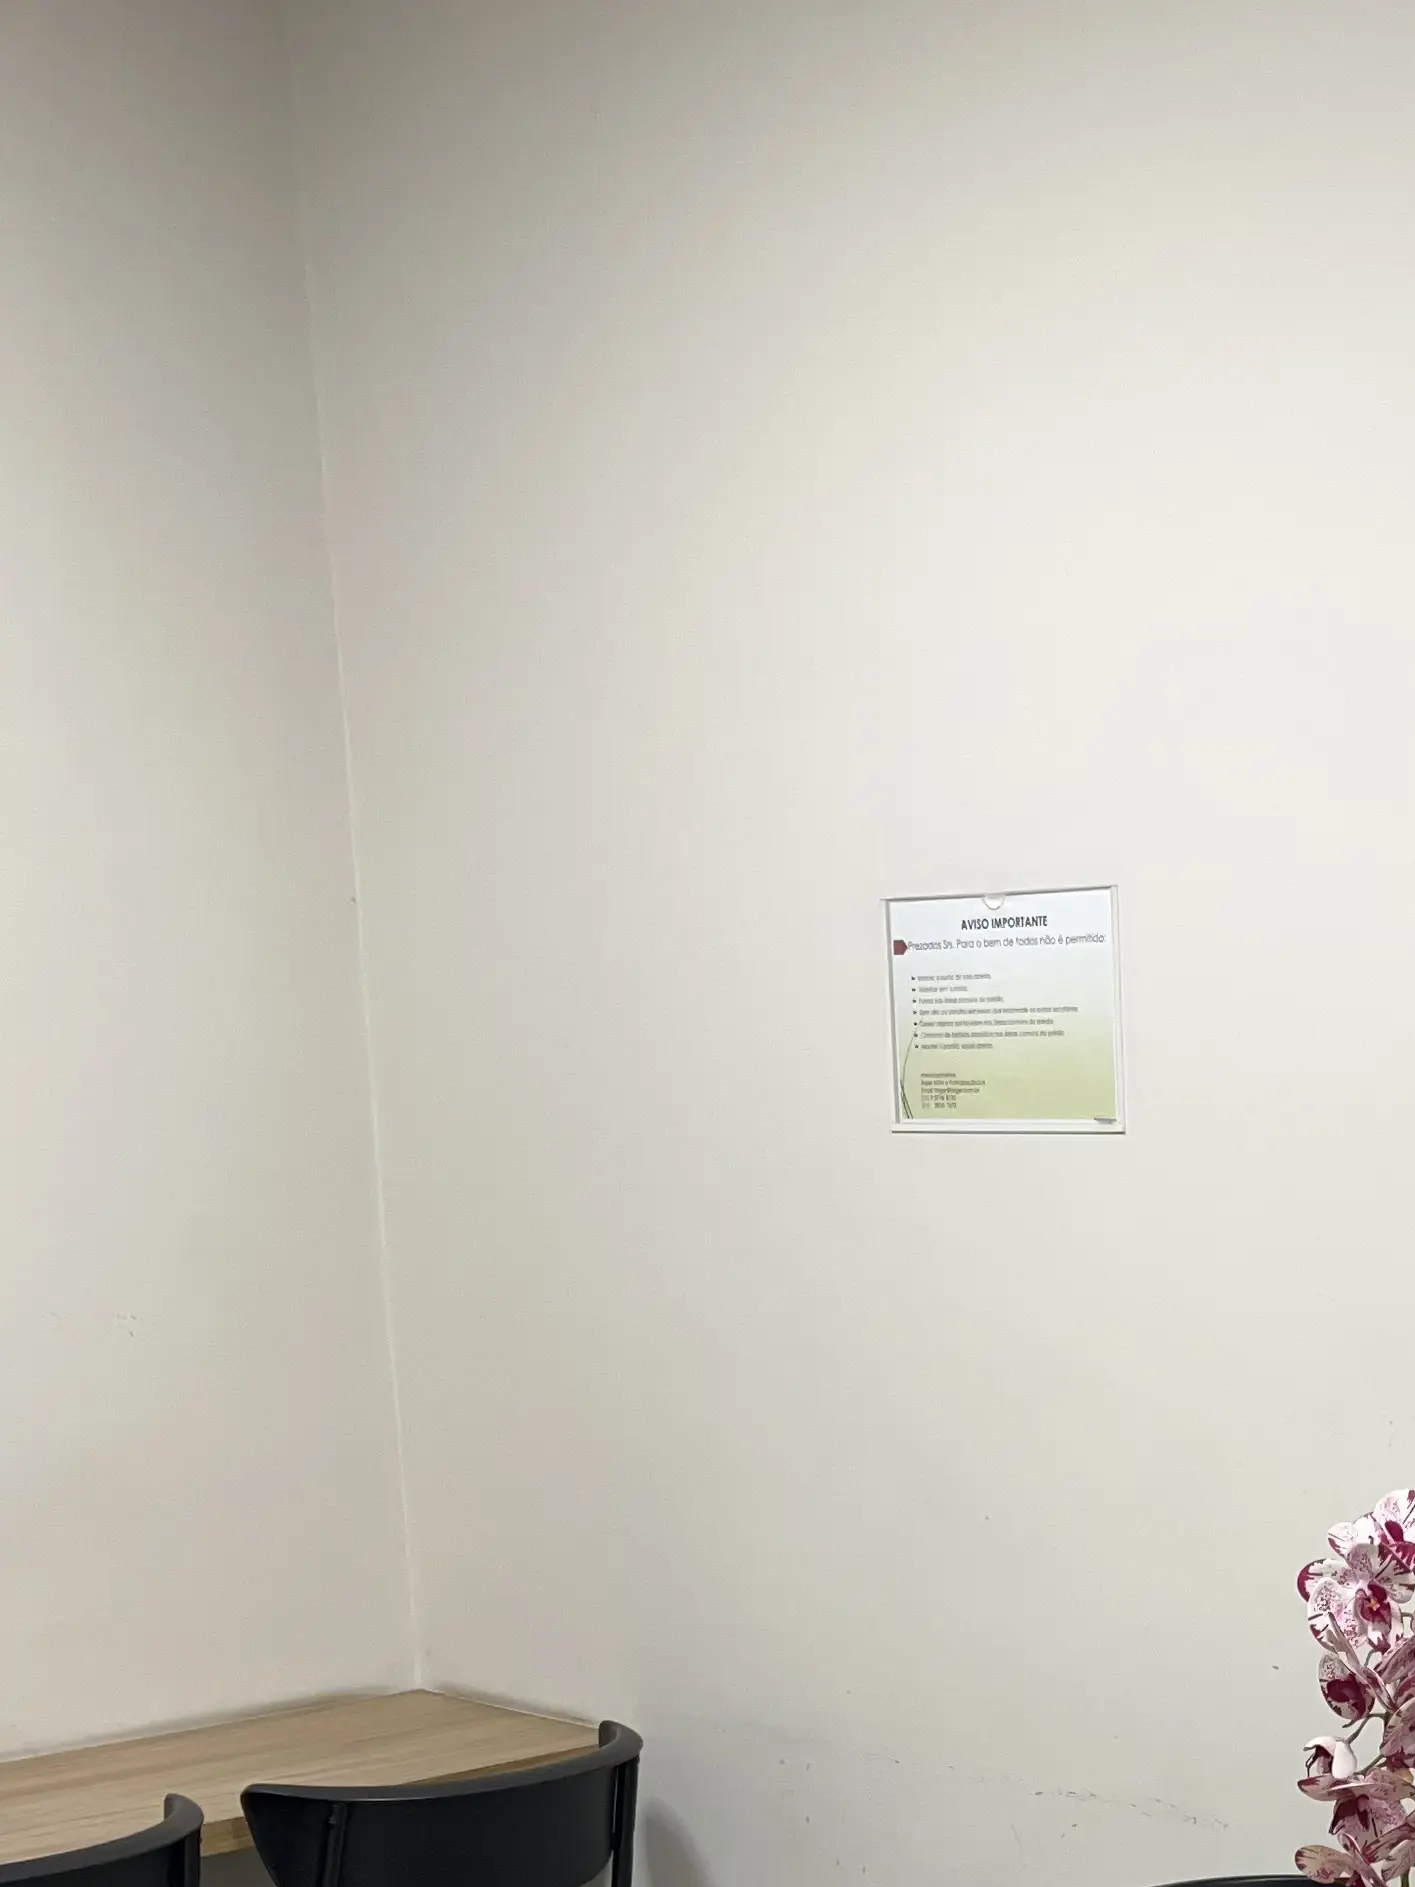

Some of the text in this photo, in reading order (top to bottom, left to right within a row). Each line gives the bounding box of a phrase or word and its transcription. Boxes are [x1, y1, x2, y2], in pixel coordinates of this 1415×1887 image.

[961, 915, 1048, 931] AVISO IMPORTANTE
[957, 938, 975, 949] Para
[983, 937, 1002, 948] bem
[1003, 937, 1014, 947] de
[1040, 935, 1056, 945] não
